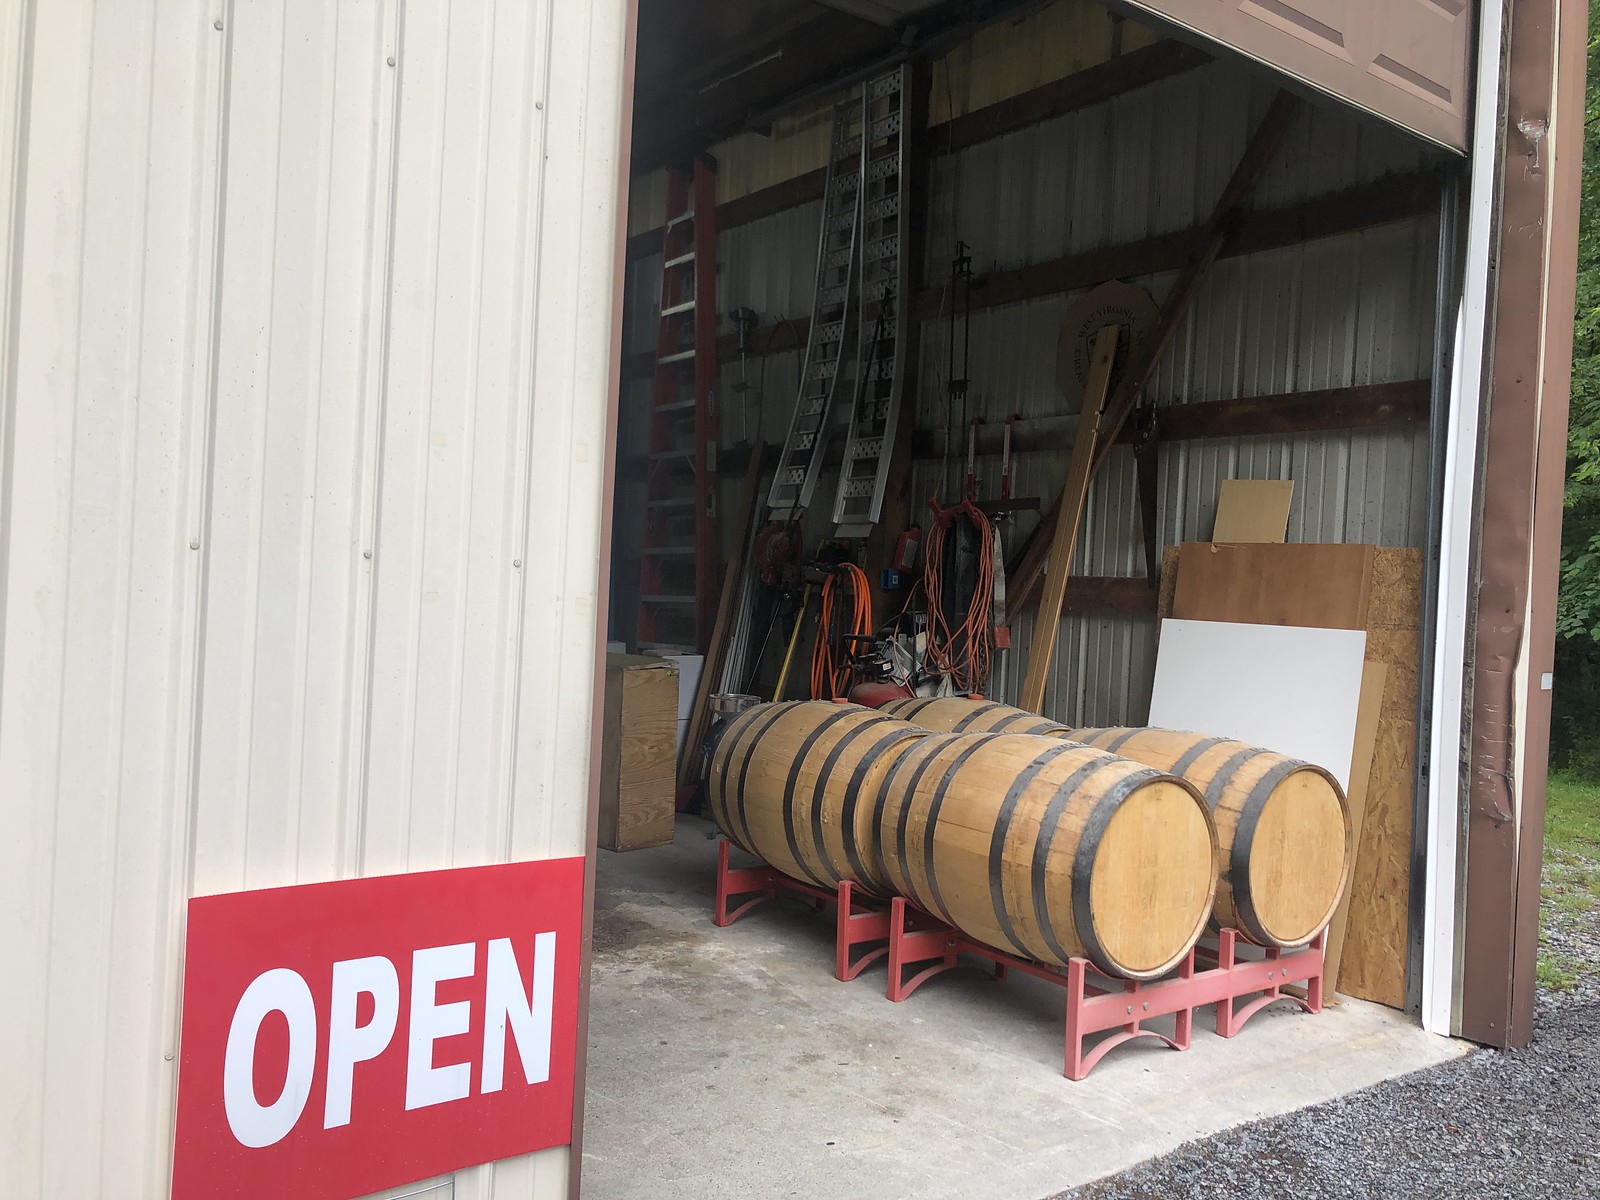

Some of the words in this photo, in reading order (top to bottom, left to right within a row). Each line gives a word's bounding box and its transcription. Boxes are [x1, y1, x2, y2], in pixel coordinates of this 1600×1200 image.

[1077, 312, 1097, 338] WEST
[1096, 304, 1136, 323] VIRGINIA
[223, 931, 556, 1148] OPEN
